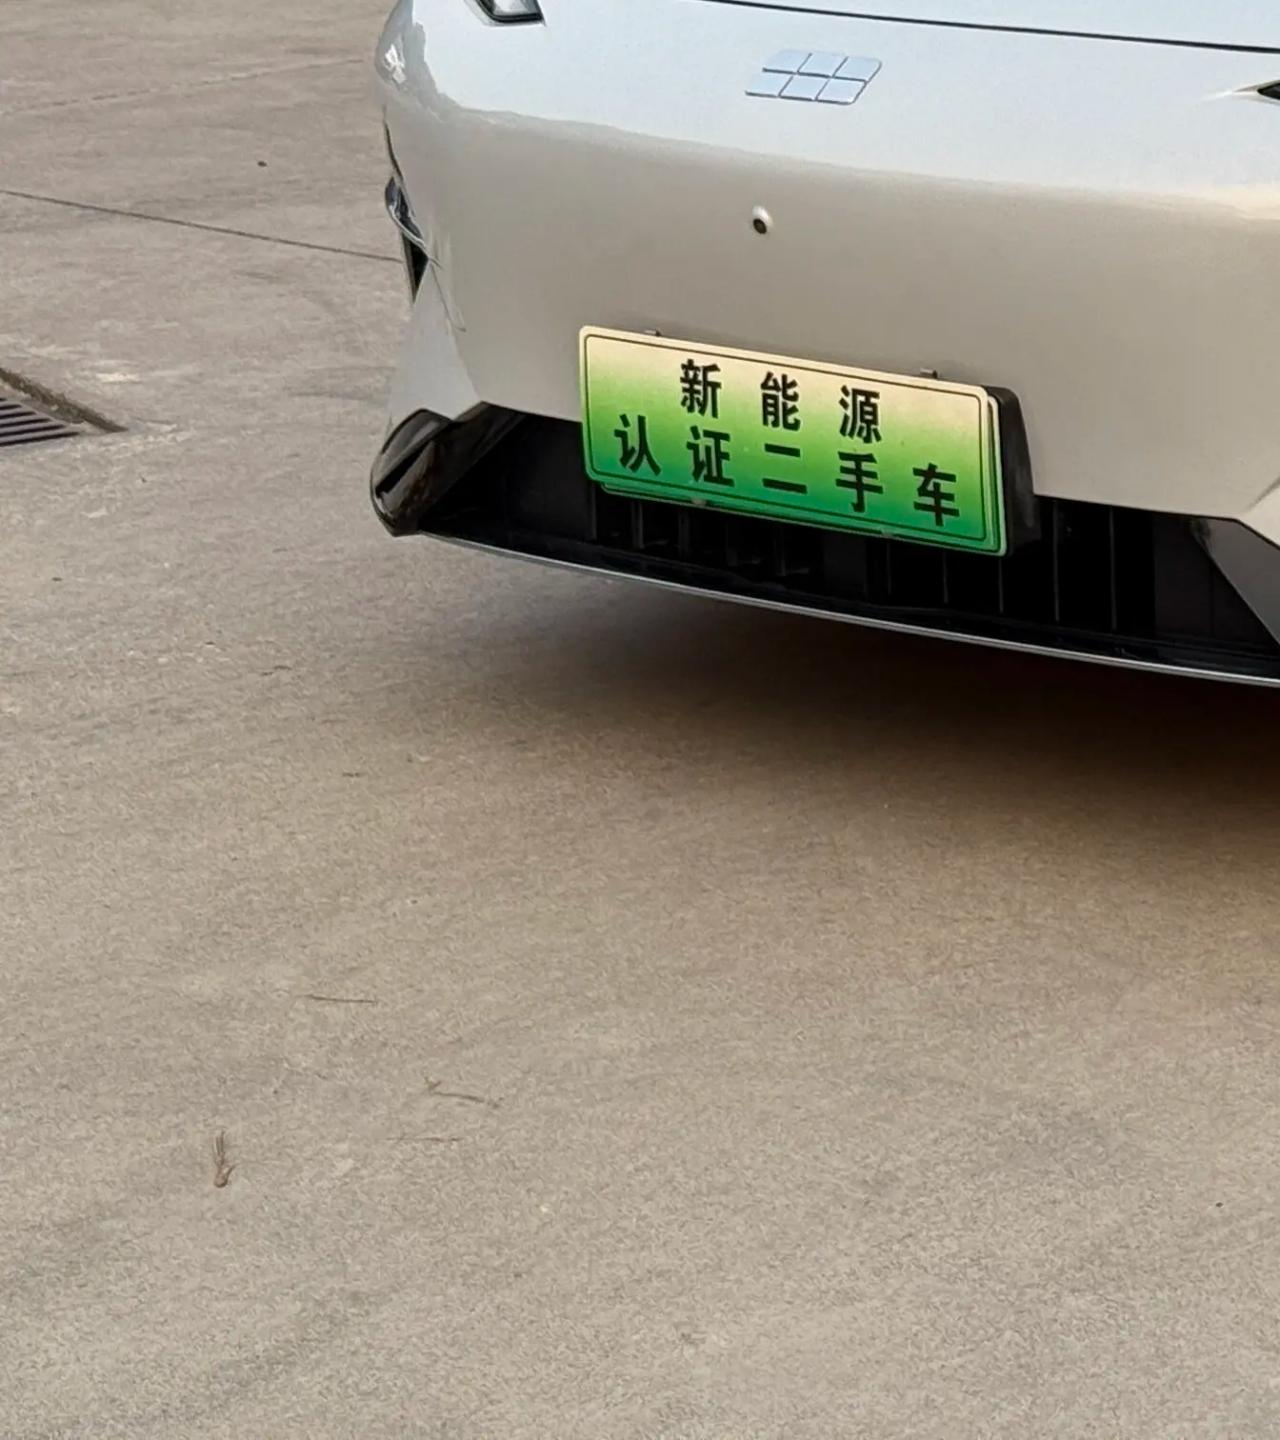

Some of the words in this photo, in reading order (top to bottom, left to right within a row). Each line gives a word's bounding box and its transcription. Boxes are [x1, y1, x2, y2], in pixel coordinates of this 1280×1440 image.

[679, 359, 883, 444] 新能源
[614, 413, 960, 527] 认证二手车
